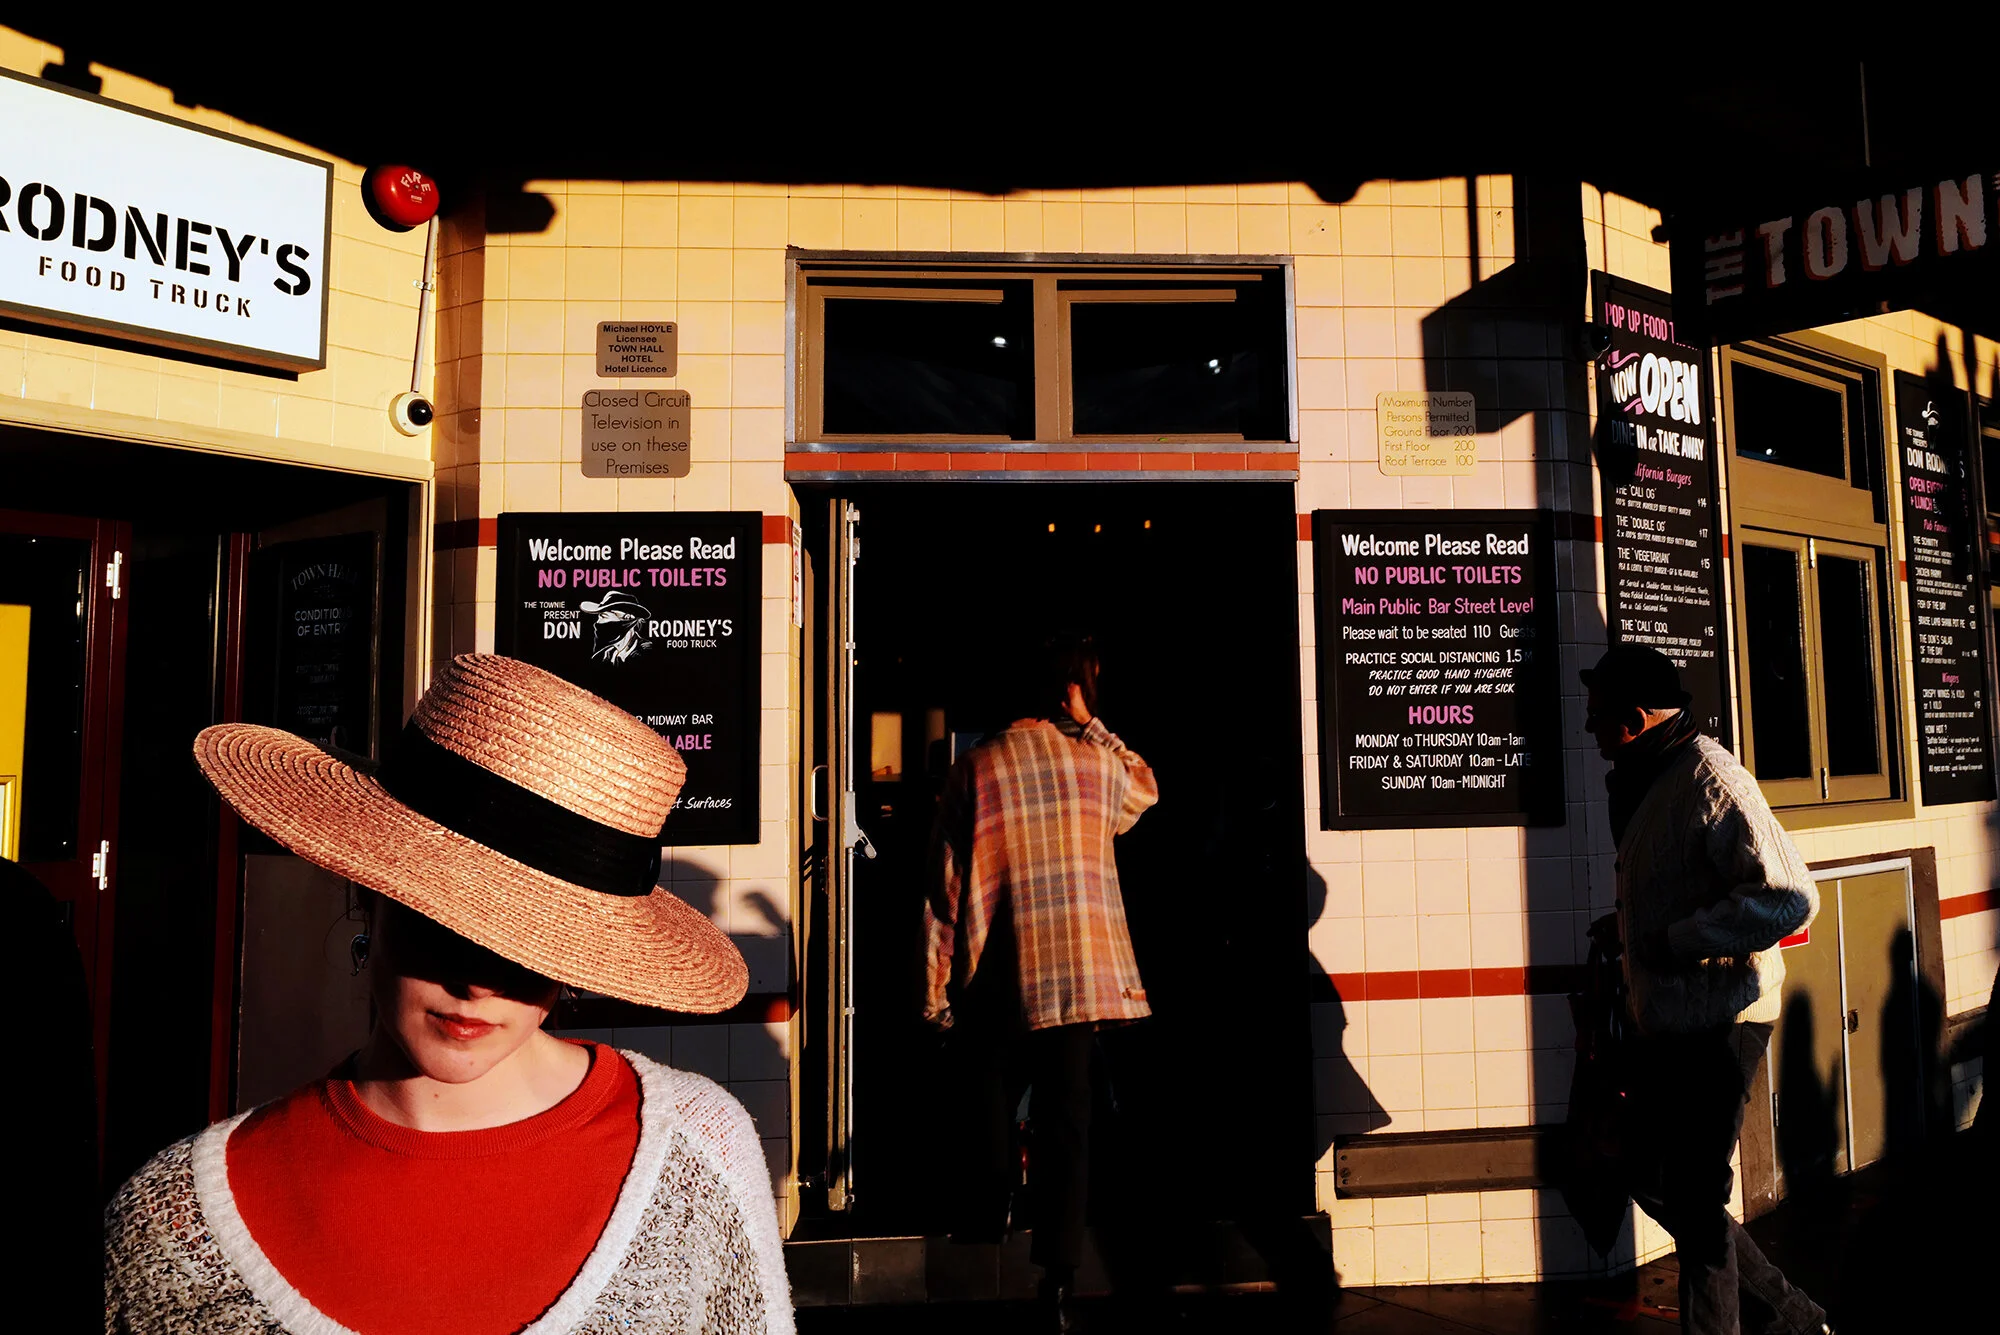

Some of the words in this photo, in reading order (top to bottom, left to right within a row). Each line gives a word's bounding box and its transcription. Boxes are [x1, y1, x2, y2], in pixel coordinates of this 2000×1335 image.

[401, 172, 431, 192] FIRE
[0, 176, 311, 296] ODNEY'S
[1705, 228, 1745, 305] THE
[39, 256, 126, 292] FOOD
[150, 279, 251, 318] TRUCK
[603, 325, 638, 333] Michael
[640, 325, 672, 333] HOYLE
[1605, 302, 1625, 329] POP
[1627, 309, 1641, 333] UP
[1643, 313, 1668, 341] FOOD
[616, 335, 657, 343] Licensee
[608, 345, 637, 353] TOWN
[640, 345, 664, 353] HALL
[622, 355, 653, 363] HOTEL
[605, 365, 629, 373] Hotel
[632, 365, 667, 373] Licence
[1610, 361, 1638, 403] NOW
[1640, 353, 1700, 425] OPEN
[584, 391, 639, 407] Closed
[645, 391, 690, 407] Circuit
[1383, 397, 1429, 407] Maximum
[1433, 397, 1472, 407] Number
[591, 414, 662, 429] Television
[668, 417, 679, 429] in
[1387, 411, 1422, 422] Persons
[1425, 411, 1469, 422] Permitted
[1384, 426, 1421, 437] Ground
[1425, 426, 1449, 437] Floor
[1453, 426, 1475, 437] 200
[591, 441, 616, 452] use
[622, 441, 640, 452] on
[647, 436, 687, 452] these
[1385, 440, 1403, 451] First
[1406, 440, 1430, 451] Floor
[1454, 440, 1475, 451] 200
[1636, 424, 1648, 450] IN
[1656, 429, 1680, 457] TAKE
[1681, 433, 1705, 461] AWAY
[606, 459, 669, 474] Premises
[1385, 455, 1407, 466] Roof
[1411, 456, 1447, 466] Terrace
[1456, 455, 1473, 466] 100
[1906, 448, 1923, 470] DON
[1634, 462, 1664, 482] lifornia
[1666, 468, 1692, 489] Burgers
[1909, 476, 1925, 493] OPEN
[1616, 514, 1629, 527] THE
[1616, 529, 1621, 538] 2
[529, 538, 611, 561] Welcome
[621, 538, 683, 561] Please
[690, 536, 735, 560] Read
[1342, 534, 1419, 556] Welcome
[1425, 534, 1480, 556] Please
[1486, 533, 1529, 555] Read
[1617, 547, 1630, 560] THE
[538, 569, 566, 588] NO
[573, 568, 641, 588] PUBLIC
[648, 568, 727, 588] TOILETS
[1355, 567, 1378, 585] NO
[1385, 567, 1446, 585] PUBLIC
[1452, 566, 1522, 584] TOILETS
[524, 601, 537, 609] THE
[539, 601, 565, 609] TOWNIE
[1342, 598, 1375, 615] Main
[1379, 598, 1421, 615] Public
[1428, 598, 1451, 615] Bar
[1455, 598, 1496, 615] Street
[1500, 597, 1534, 614] Level
[544, 610, 580, 620] PRESENT
[297, 625, 310, 637] OF
[543, 621, 581, 639] DON
[649, 619, 733, 638] RODNEY'S
[1343, 626, 1376, 640] Please
[1377, 626, 1399, 640] wait
[1402, 626, 1413, 640] to
[1416, 625, 1429, 639] be
[1431, 625, 1467, 639] seated
[1473, 625, 1491, 638] 110
[1621, 619, 1634, 631] THE
[666, 639, 688, 649] FOOD
[690, 639, 717, 648] TRUCK
[1345, 652, 1396, 665] PRACTICE
[1400, 652, 1436, 664] SOCIAL
[1439, 651, 1500, 664] DISTANCING
[1506, 649, 1522, 663] 1.5
[1369, 669, 1412, 680] PRACTICE
[1416, 669, 1440, 680] GOOD
[1444, 668, 1470, 679] HAND
[1474, 668, 1513, 679] HYGIENE
[1368, 686, 1382, 696] DO
[1387, 685, 1406, 696] NOT
[1409, 684, 1438, 695] ENTER
[1441, 684, 1452, 695] IF
[1454, 684, 1472, 694] YOU
[1474, 683, 1493, 694] ARE
[1495, 683, 1514, 694] SICK
[647, 714, 688, 726] MIDWAY
[692, 714, 713, 725] BAR
[1408, 705, 1474, 725] HOURS
[1355, 734, 1400, 748] MONDAY
[1402, 735, 1413, 747] to
[1414, 733, 1474, 747] THURSDAY
[1349, 755, 1389, 769] FRIDAY
[1393, 755, 1402, 769] &
[1405, 754, 1463, 769] SATURDAY
[1382, 776, 1426, 790] SUNDAY
[684, 796, 732, 810] Surfaces
